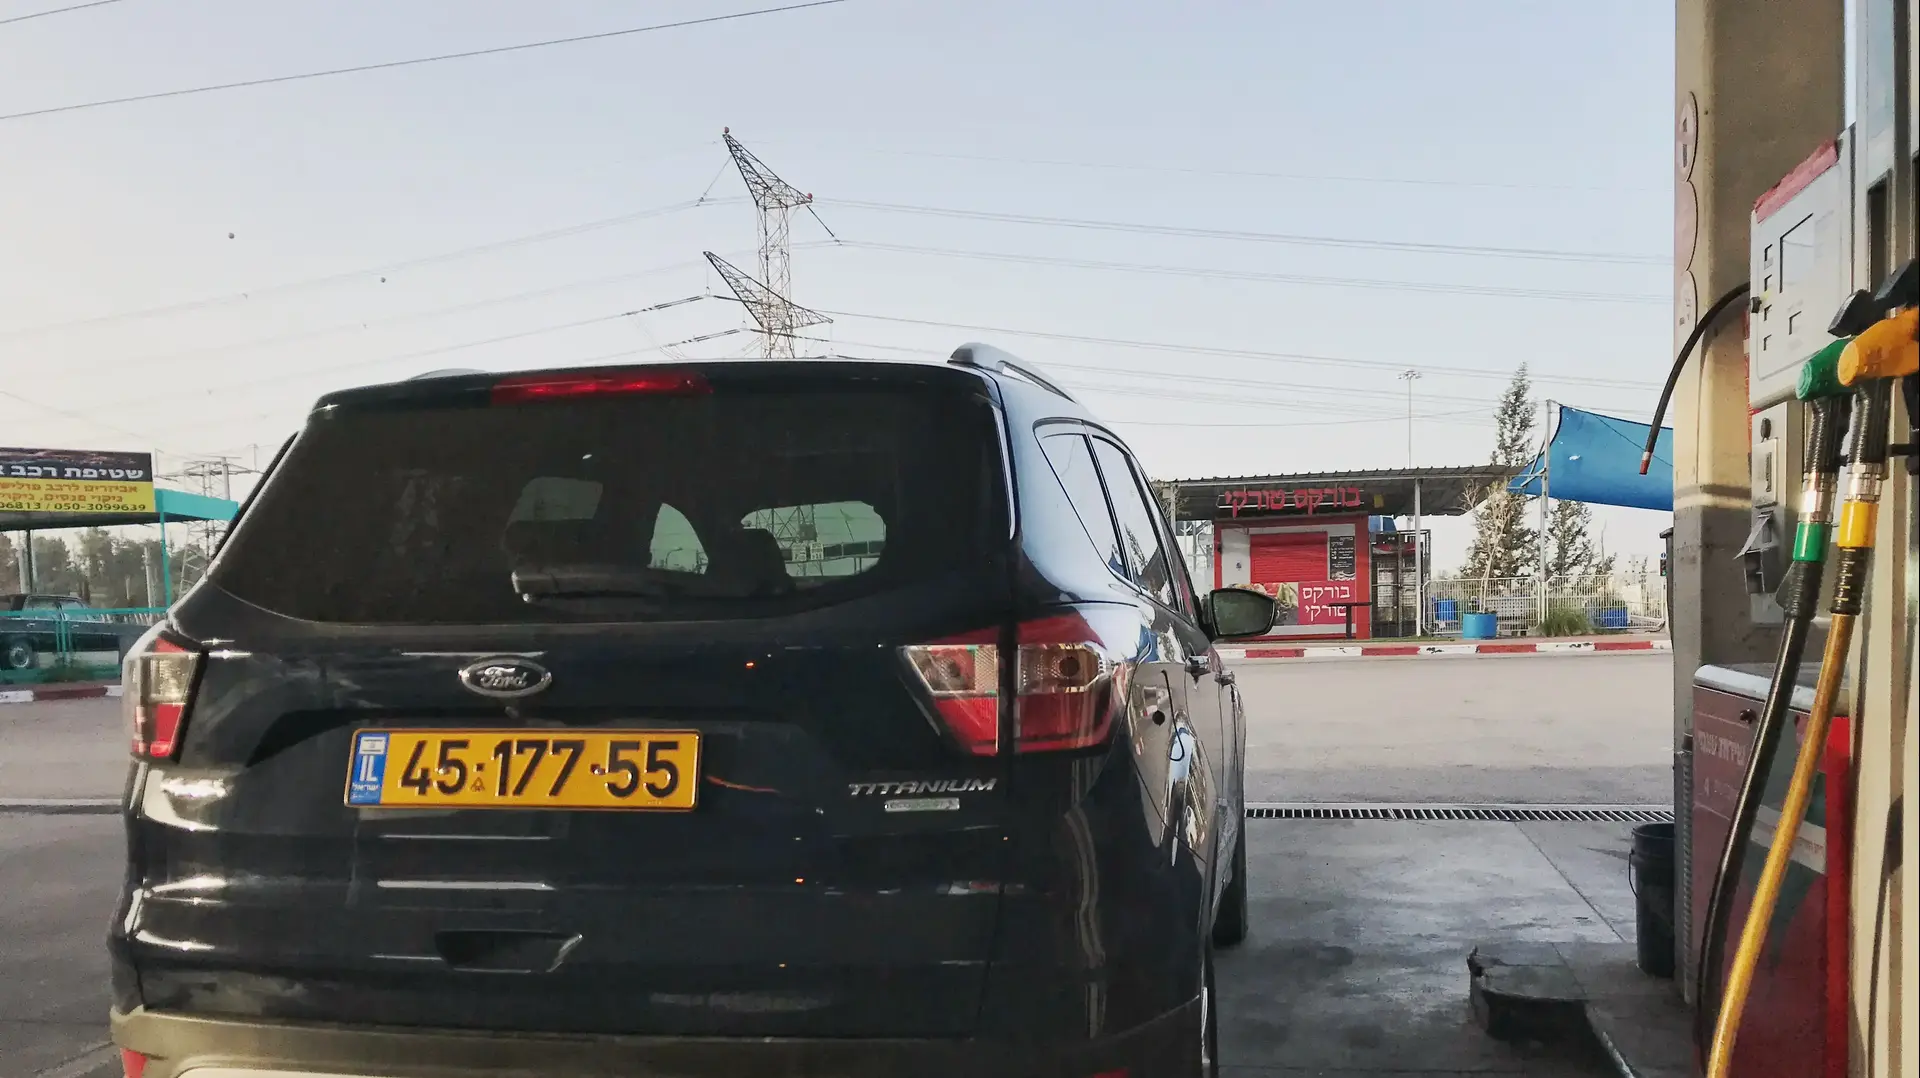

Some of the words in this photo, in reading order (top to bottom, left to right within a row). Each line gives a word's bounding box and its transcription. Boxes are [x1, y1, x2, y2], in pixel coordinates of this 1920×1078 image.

[10, 465, 57, 477] רכב
[64, 467, 144, 479] שטיפת
[54, 502, 146, 511] 050-3099639
[1224, 489, 1285, 520] טורקי
[1293, 487, 1360, 516] בורקס
[1302, 586, 1350, 604] בורקס
[475, 665, 529, 690] Ford
[360, 754, 378, 782] IL
[848, 778, 998, 796] TITANIUM
